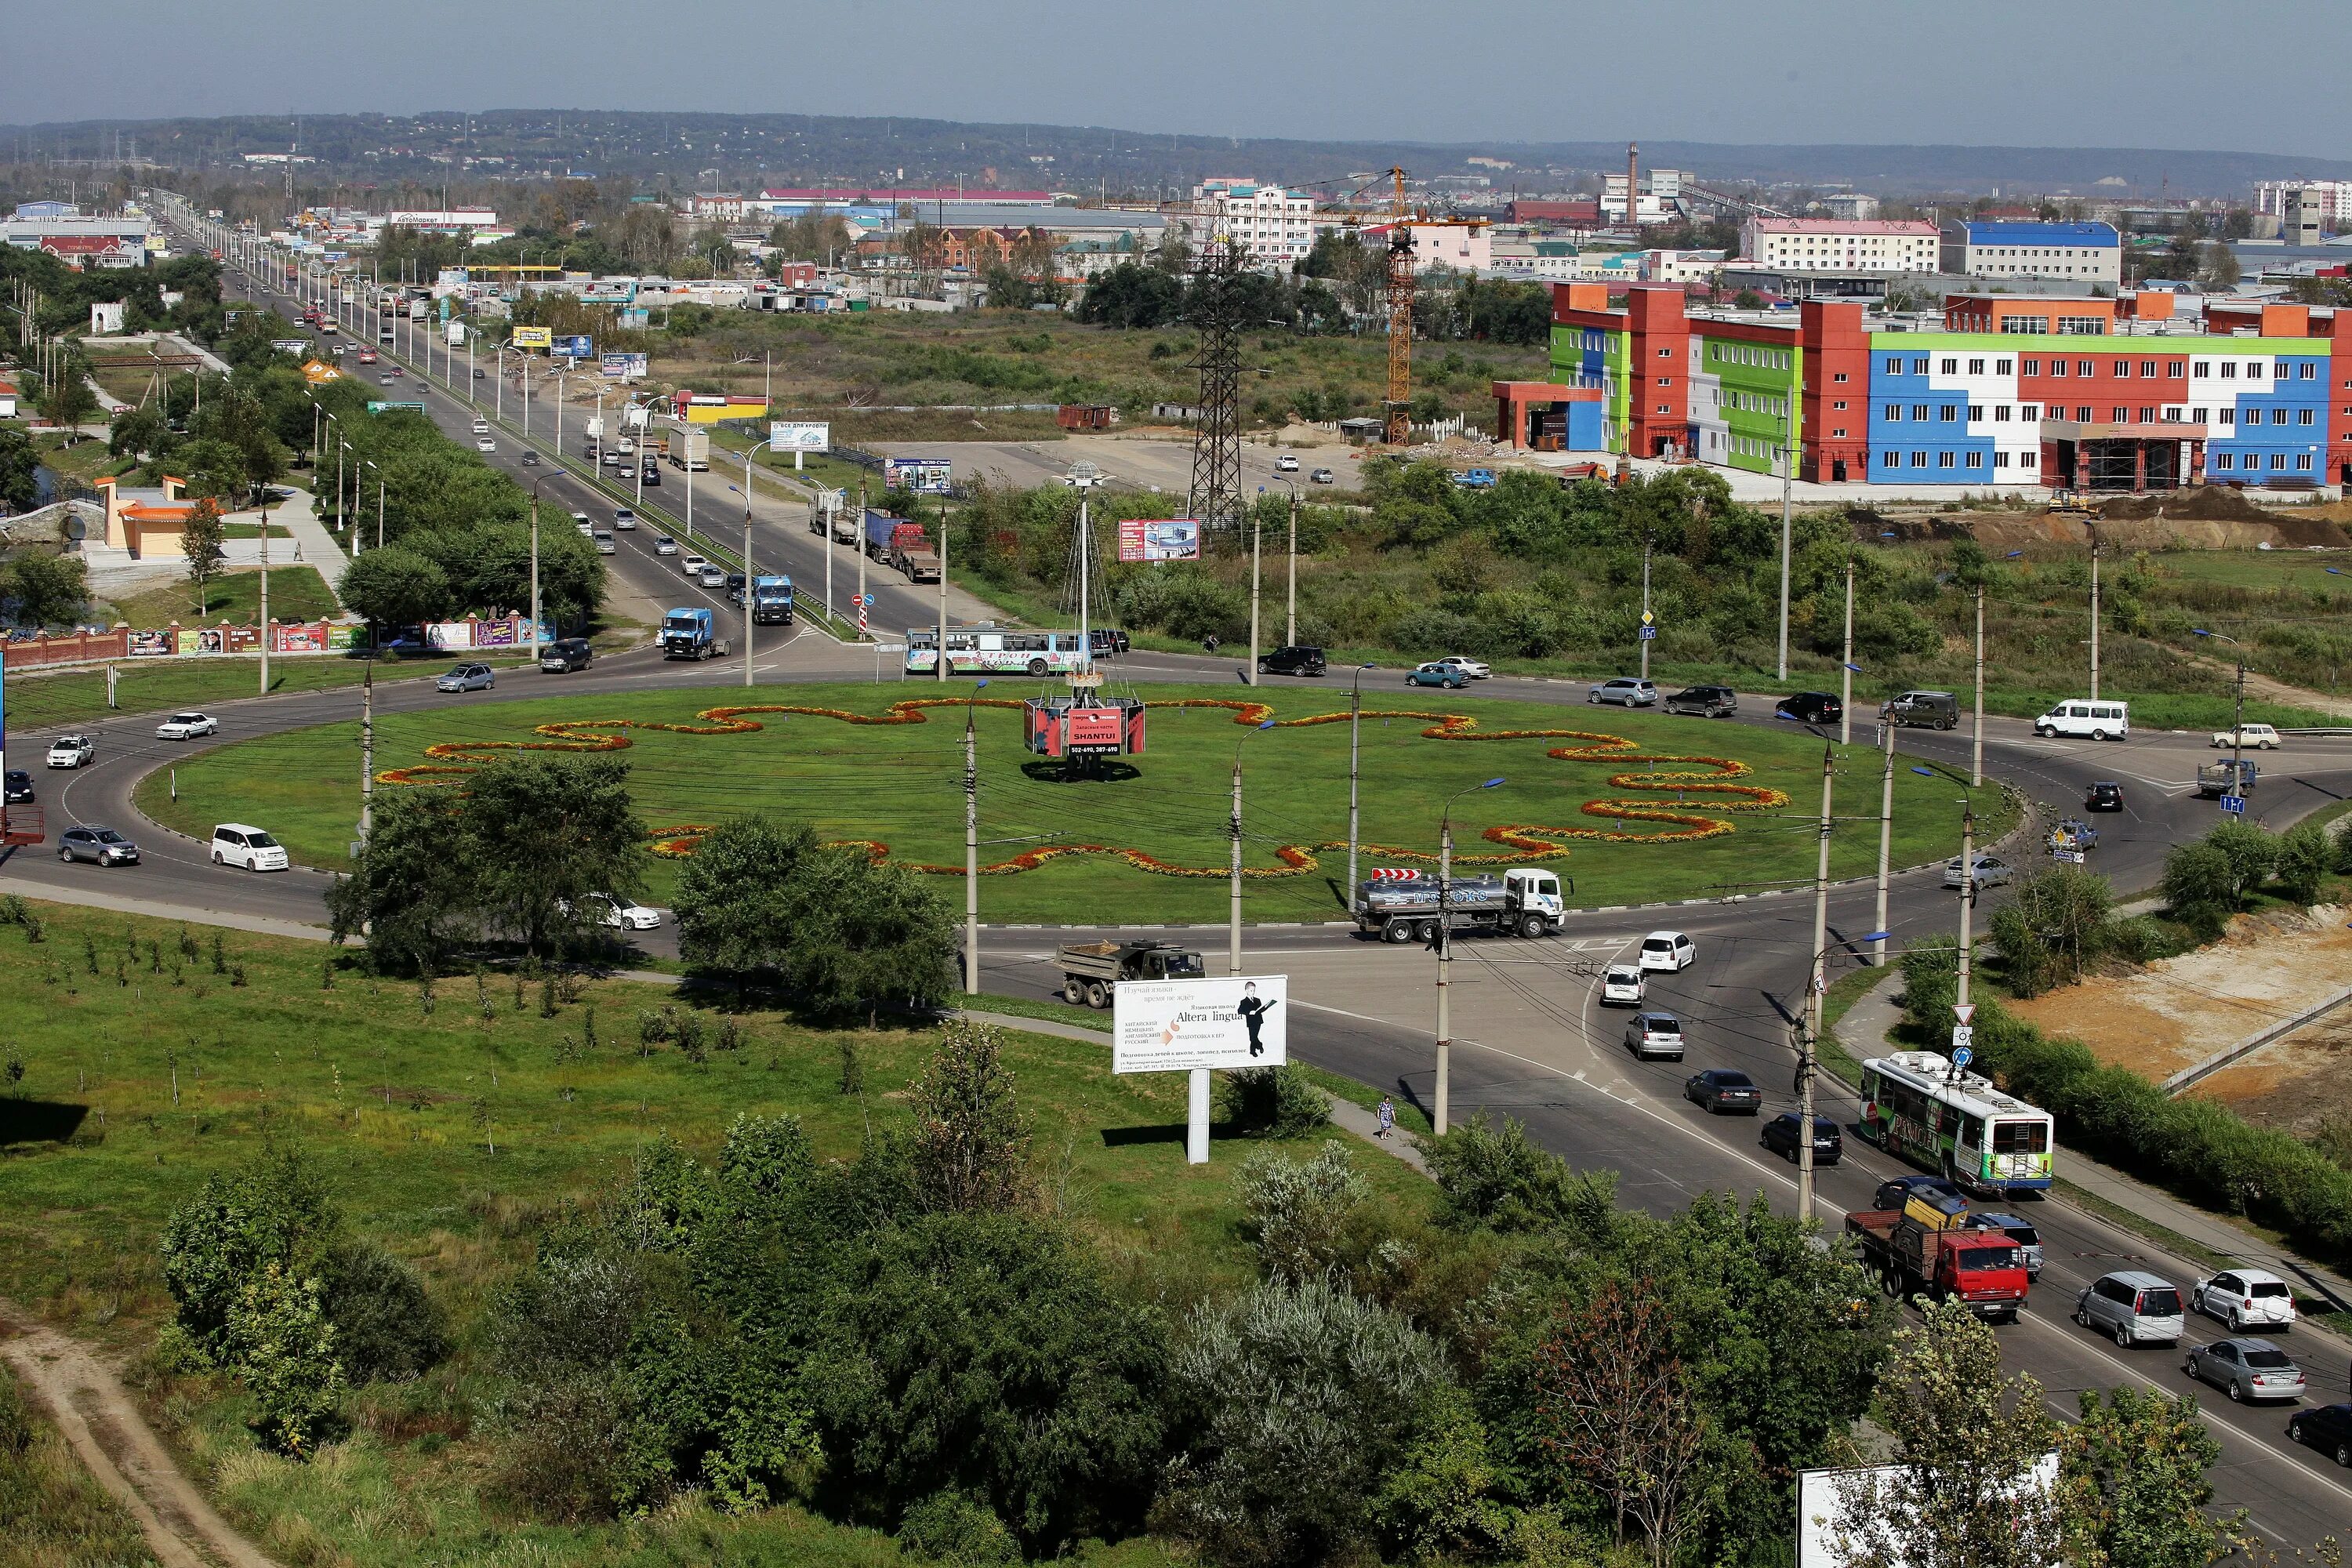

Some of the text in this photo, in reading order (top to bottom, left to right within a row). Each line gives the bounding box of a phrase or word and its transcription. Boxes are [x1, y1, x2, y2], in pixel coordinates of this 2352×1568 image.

[1414, 890, 1488, 904] МООКО
[1123, 986, 1150, 995] Изучай
[1177, 1011, 1243, 1023] Altera lingua
